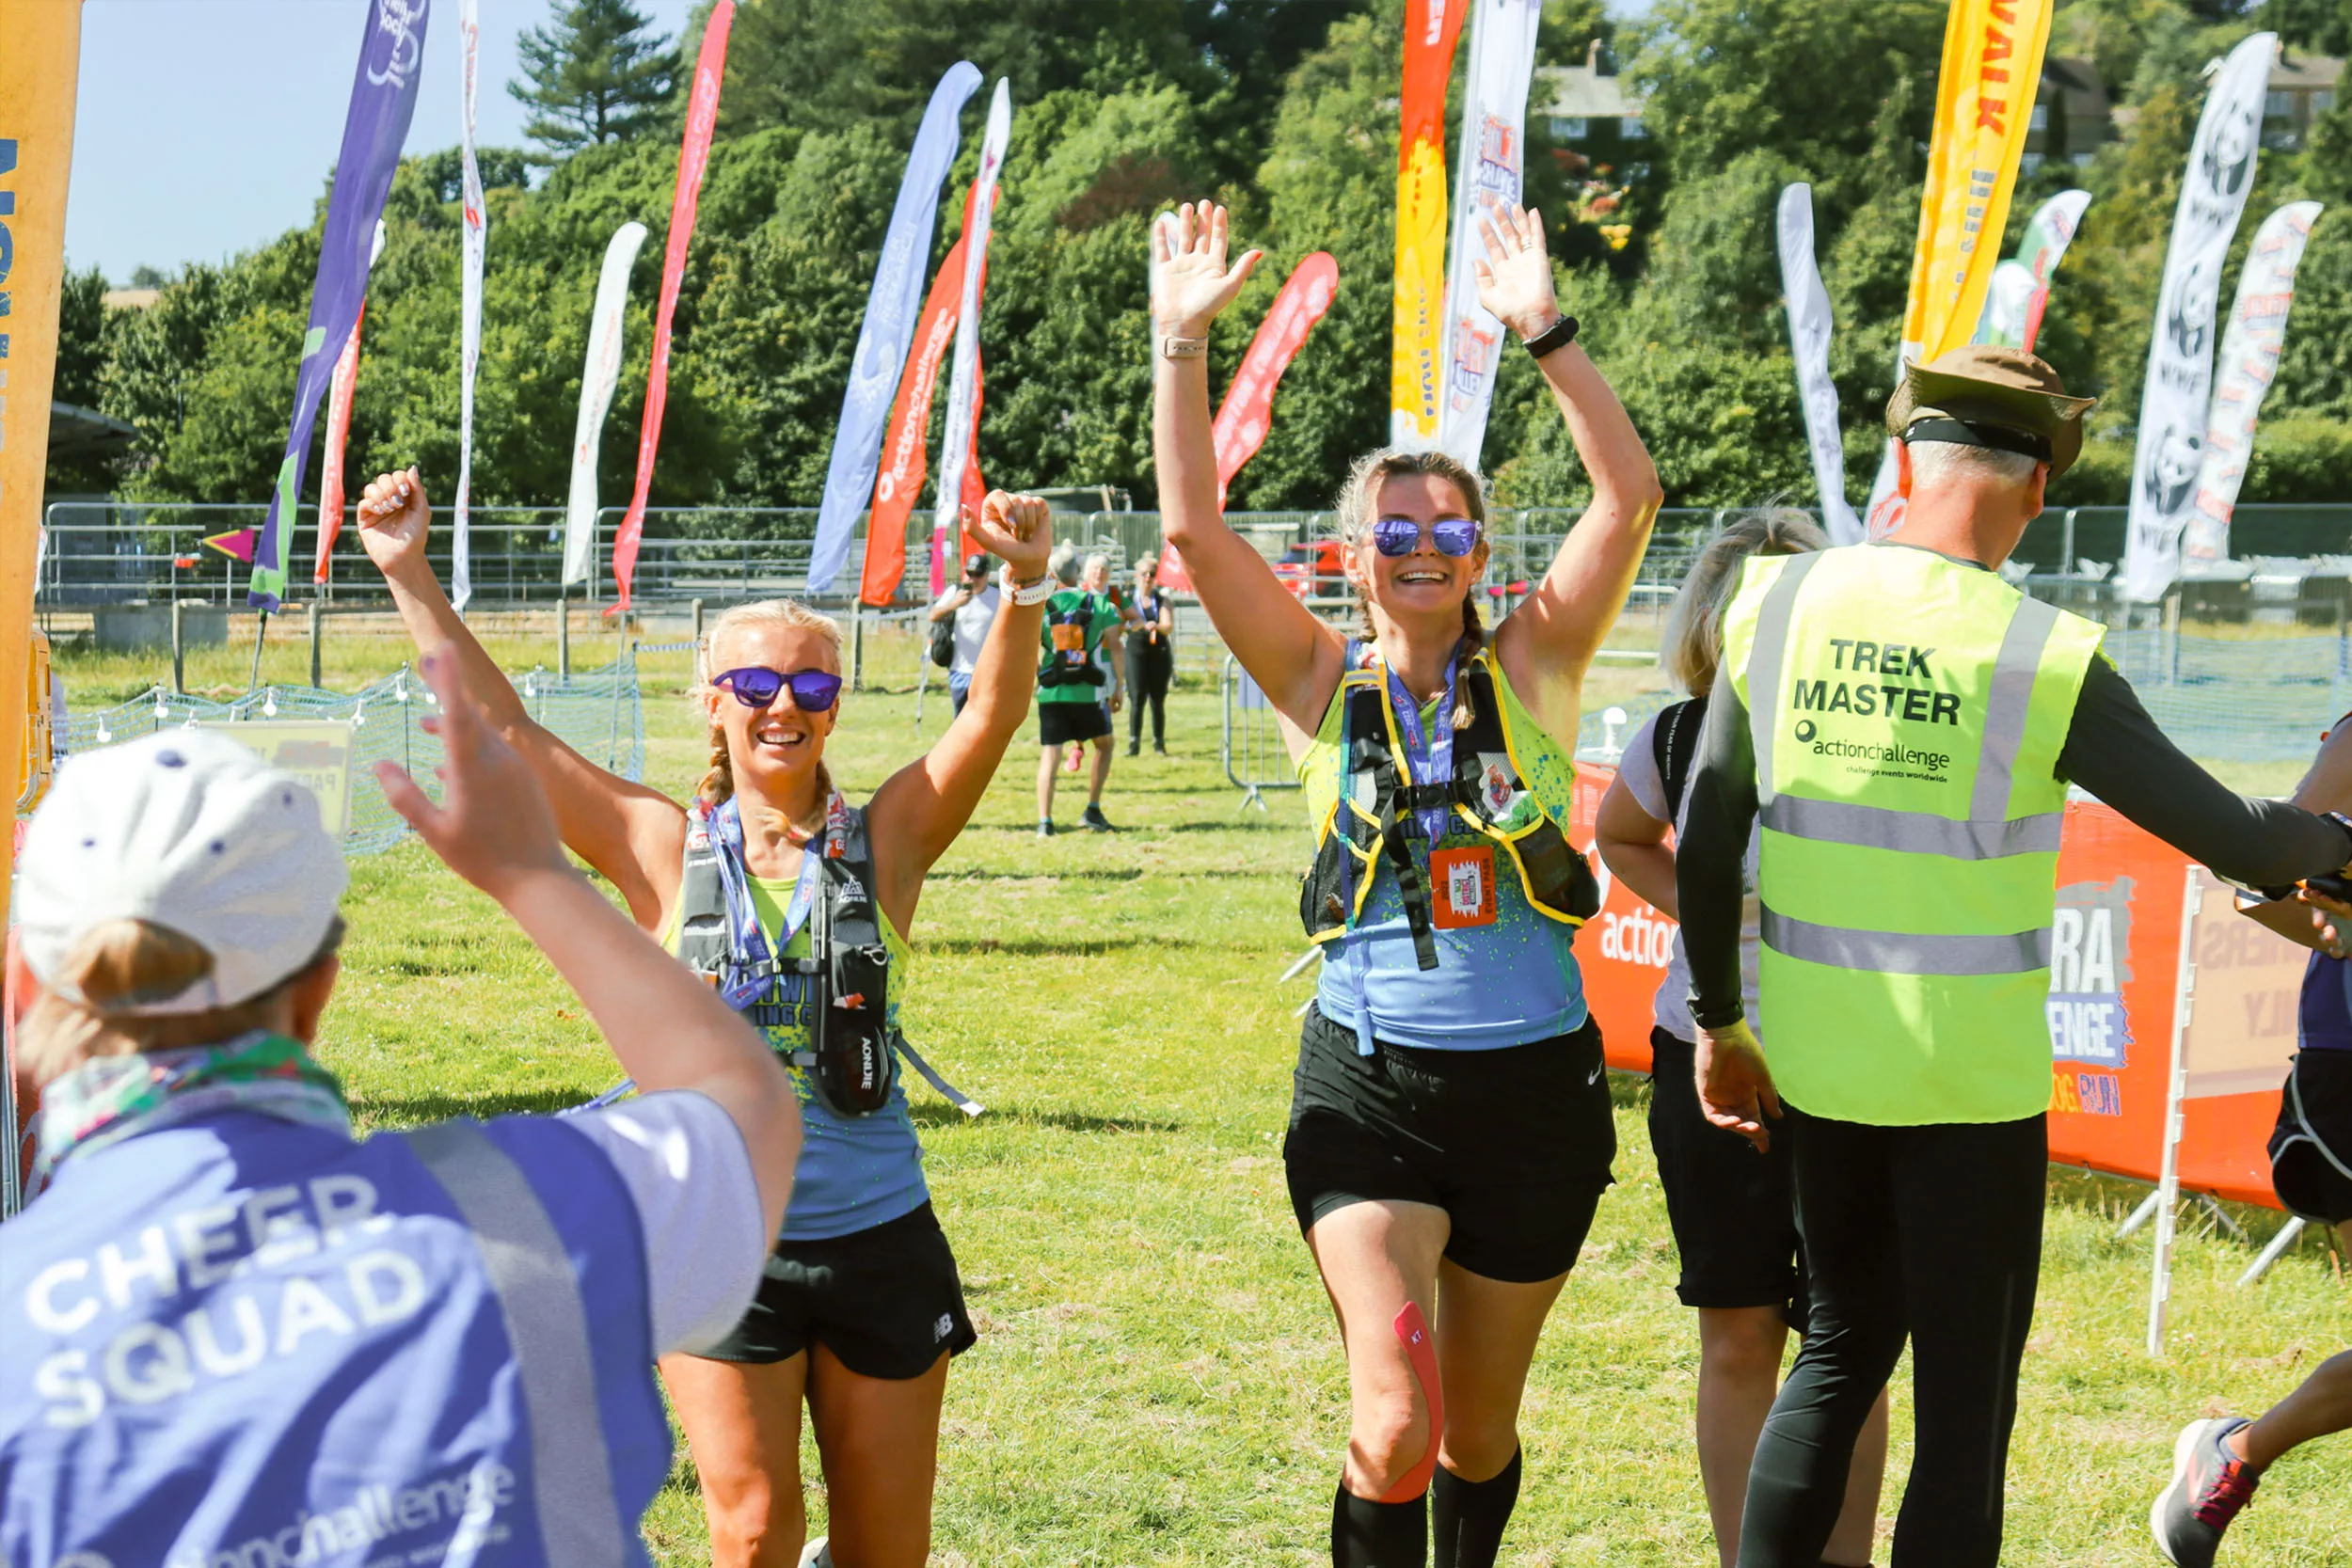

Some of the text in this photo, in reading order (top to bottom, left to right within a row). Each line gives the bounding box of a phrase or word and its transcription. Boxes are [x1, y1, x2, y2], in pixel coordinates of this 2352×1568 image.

[1830, 639, 1936, 678] TREK
[1793, 679, 1961, 725] MASTER
[1813, 739, 1950, 771] actionchallenge
[1846, 766, 1947, 783] challenge events worldwide
[1482, 857, 1492, 913] EVENT PASS
[2048, 907, 2116, 994] RA
[2046, 1001, 2116, 1058] ENGE
[25, 1175, 399, 1335] CHEER
[35, 1249, 426, 1429] SQUAD
